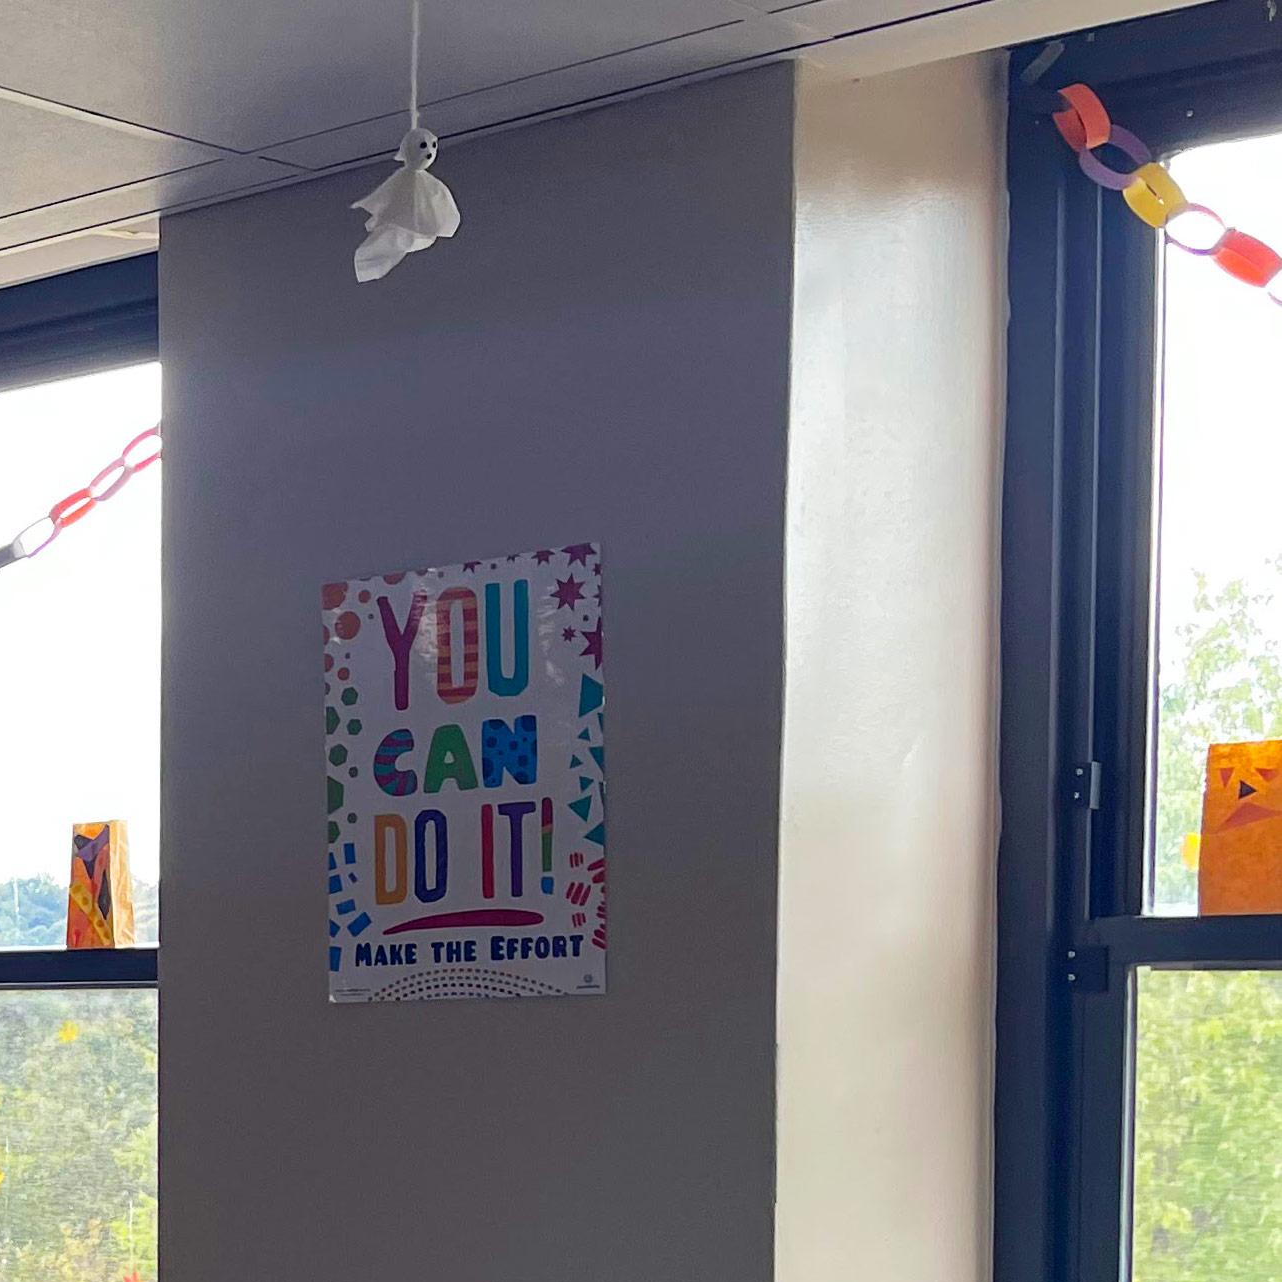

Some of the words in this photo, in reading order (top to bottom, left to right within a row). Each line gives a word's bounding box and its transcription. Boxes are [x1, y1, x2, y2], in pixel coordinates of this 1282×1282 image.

[377, 579, 529, 710] YOU
[373, 715, 538, 796] CAN
[374, 809, 448, 905] DO
[481, 797, 555, 899] IT!
[355, 941, 418, 967] MAKE
[432, 939, 476, 963] THE
[490, 934, 584, 961] EFFORT
